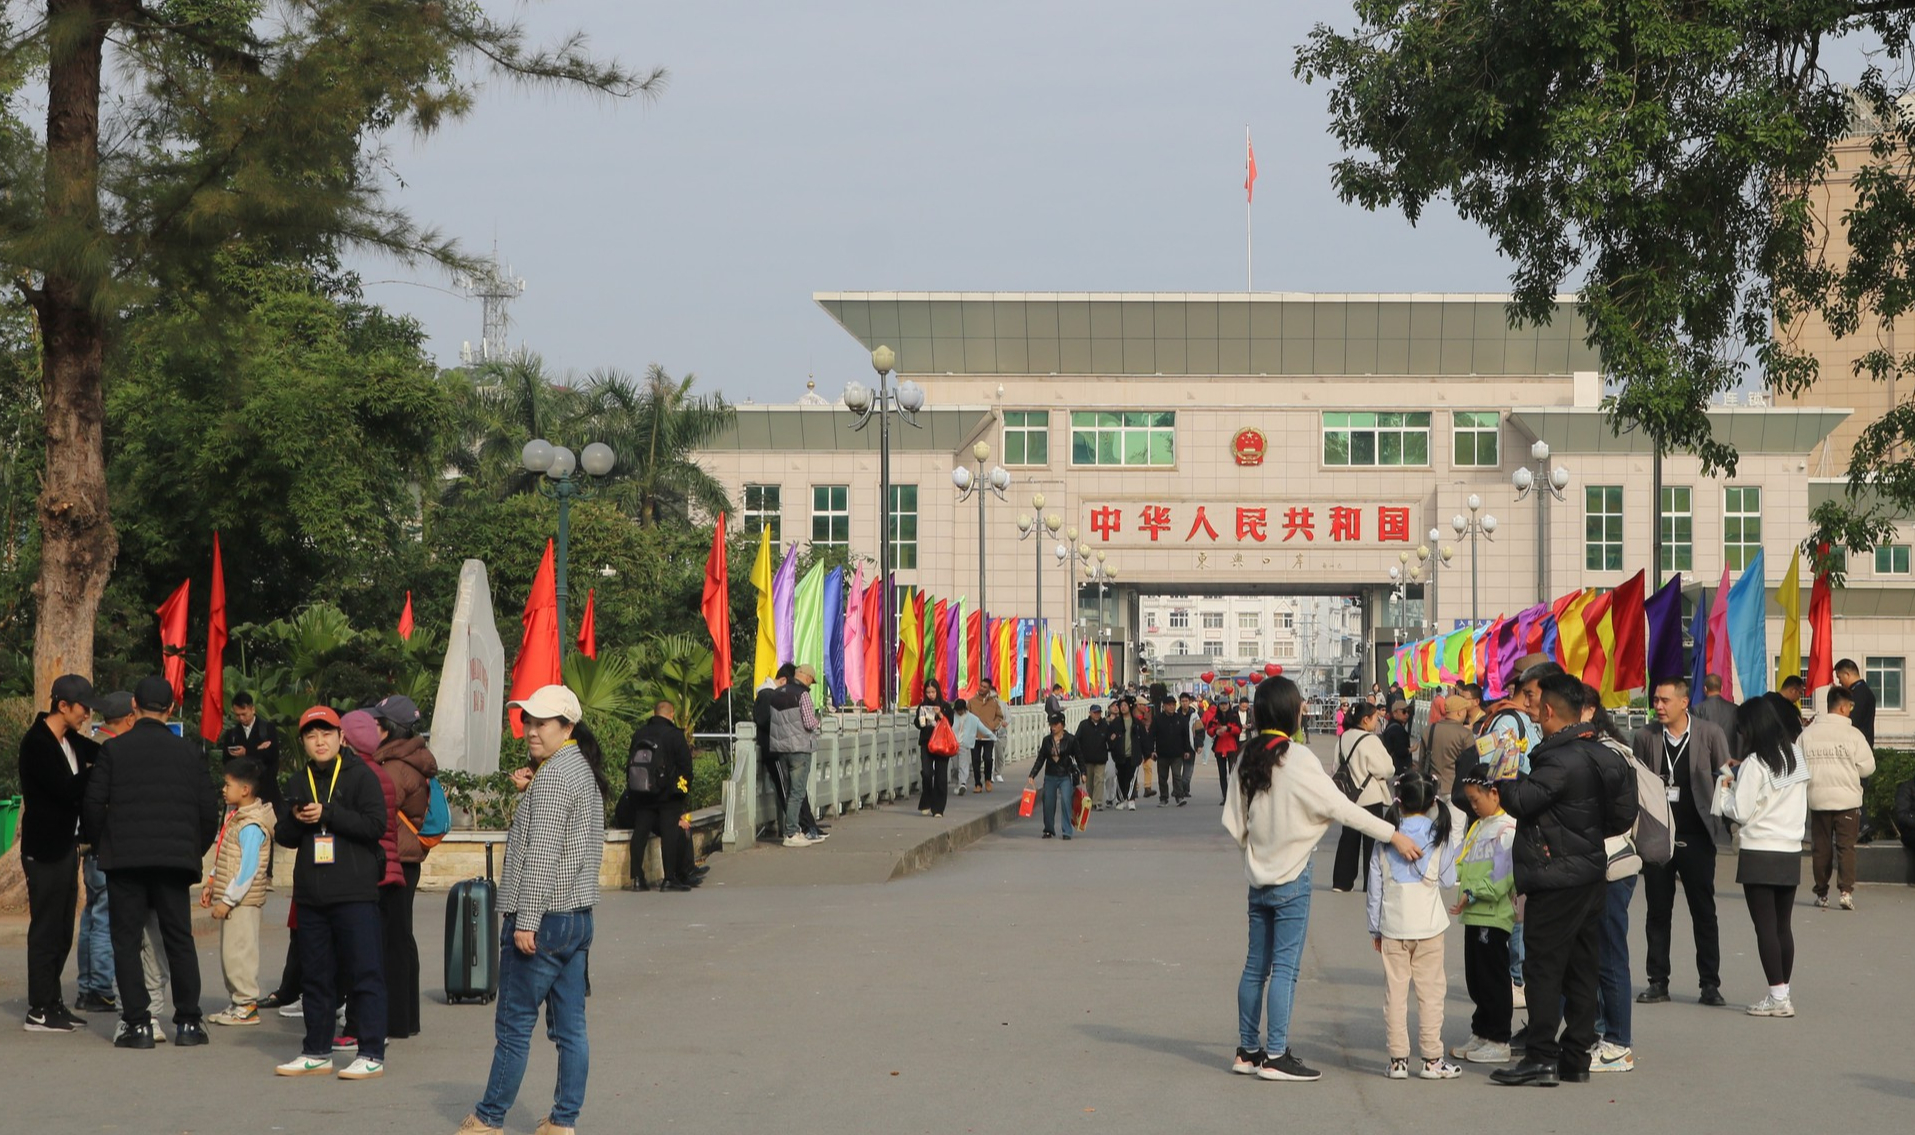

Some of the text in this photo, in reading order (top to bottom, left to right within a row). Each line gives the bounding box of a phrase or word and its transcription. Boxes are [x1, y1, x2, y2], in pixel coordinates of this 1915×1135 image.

[1090, 504, 1411, 543] 中华人民共和国
